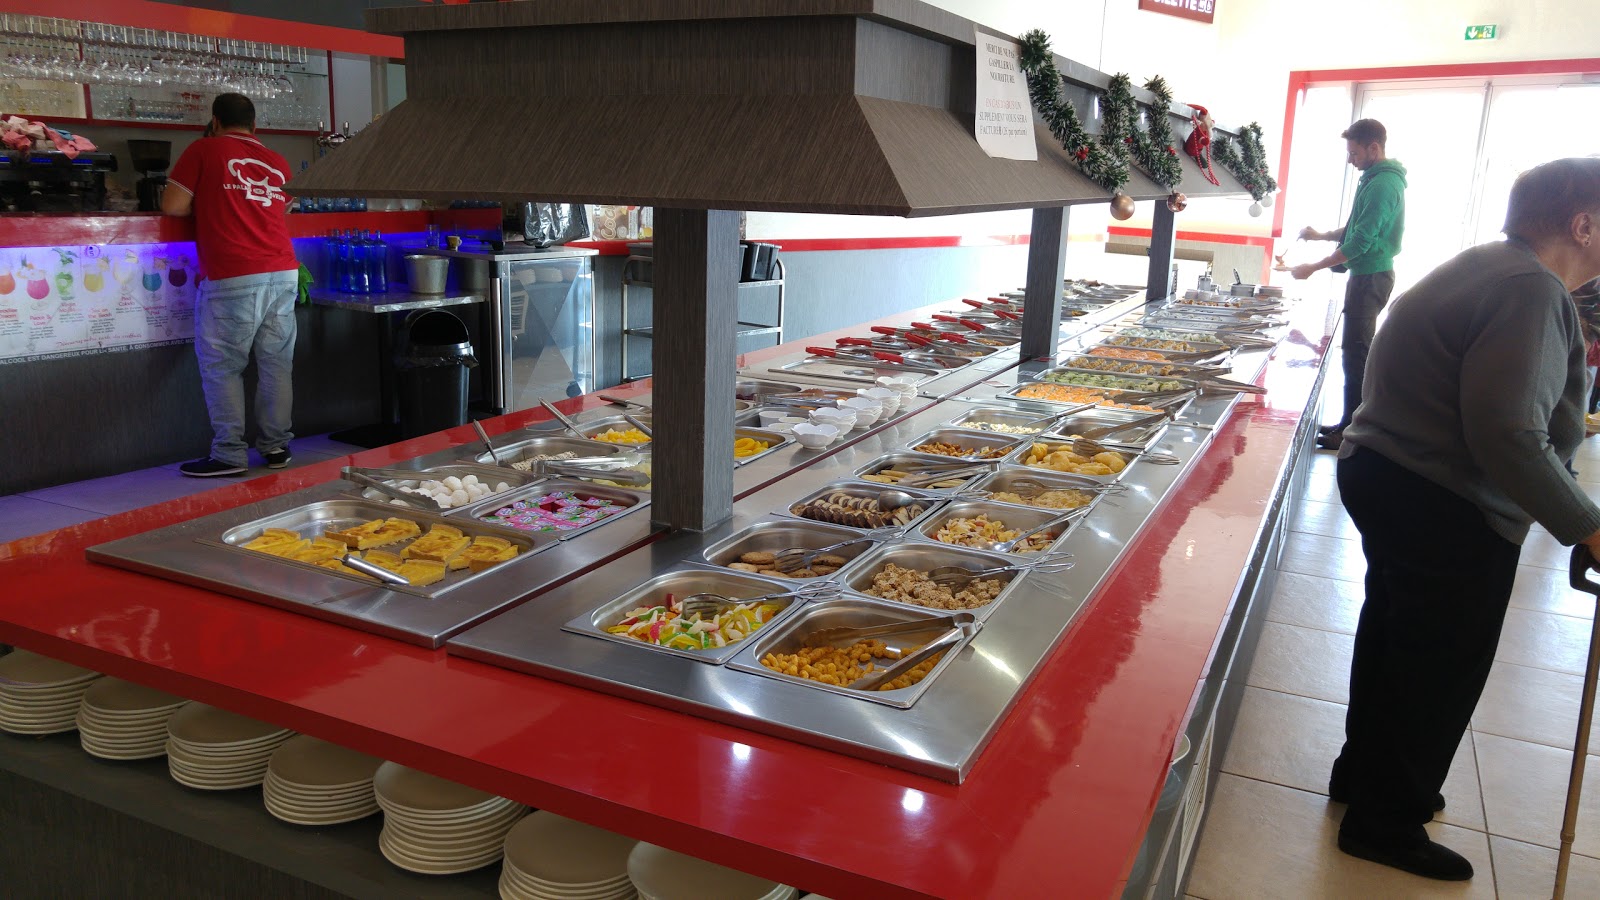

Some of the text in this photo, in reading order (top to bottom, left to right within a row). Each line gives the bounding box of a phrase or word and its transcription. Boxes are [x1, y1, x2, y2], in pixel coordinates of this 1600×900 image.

[990, 71, 1015, 84] NOURRITURE
[27, 354, 40, 362] EST
[41, 351, 80, 361] DANGEREUX
[81, 348, 98, 356] POUR
